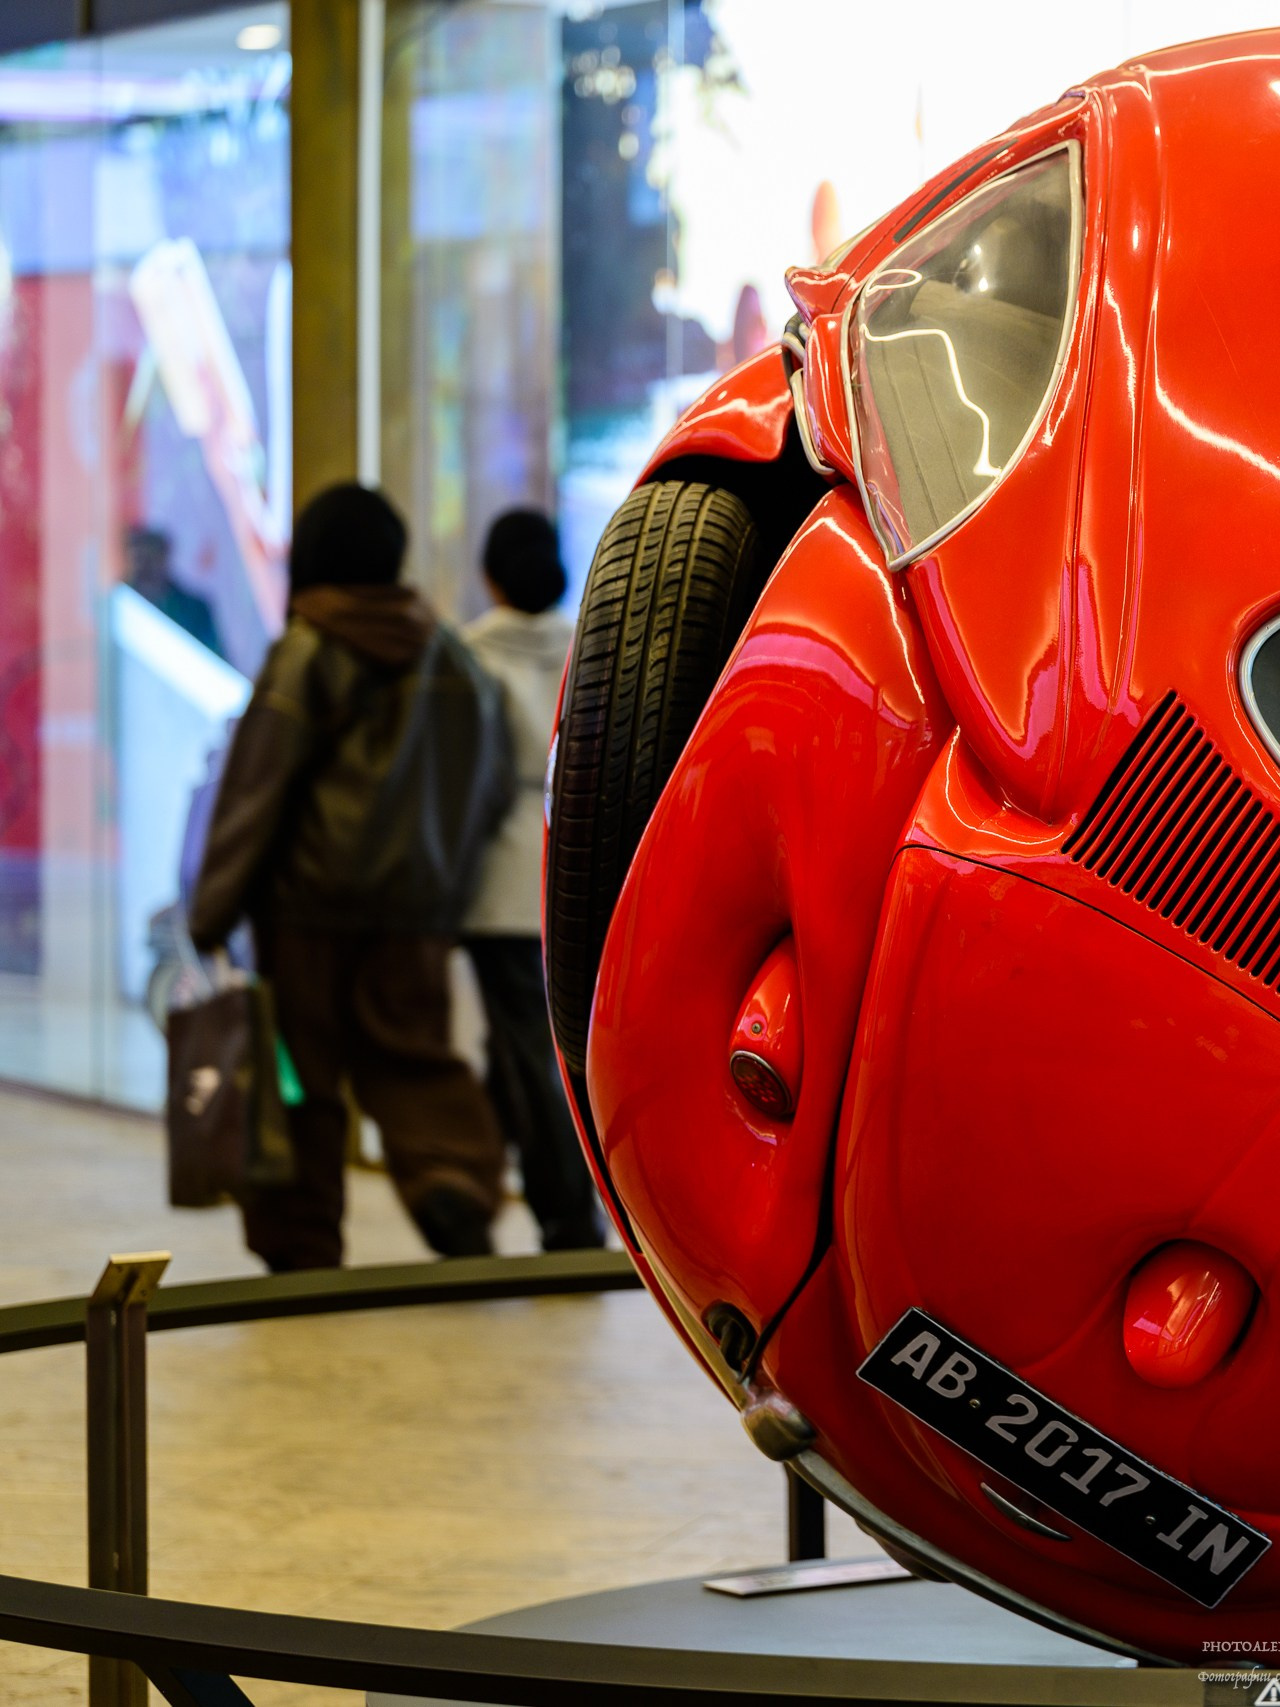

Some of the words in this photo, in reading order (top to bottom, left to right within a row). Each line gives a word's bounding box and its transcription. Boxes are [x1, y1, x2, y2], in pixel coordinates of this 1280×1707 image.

[891, 1331, 978, 1399] AB
[985, 1394, 1151, 1506] 2017
[1156, 1504, 1250, 1576] IN
